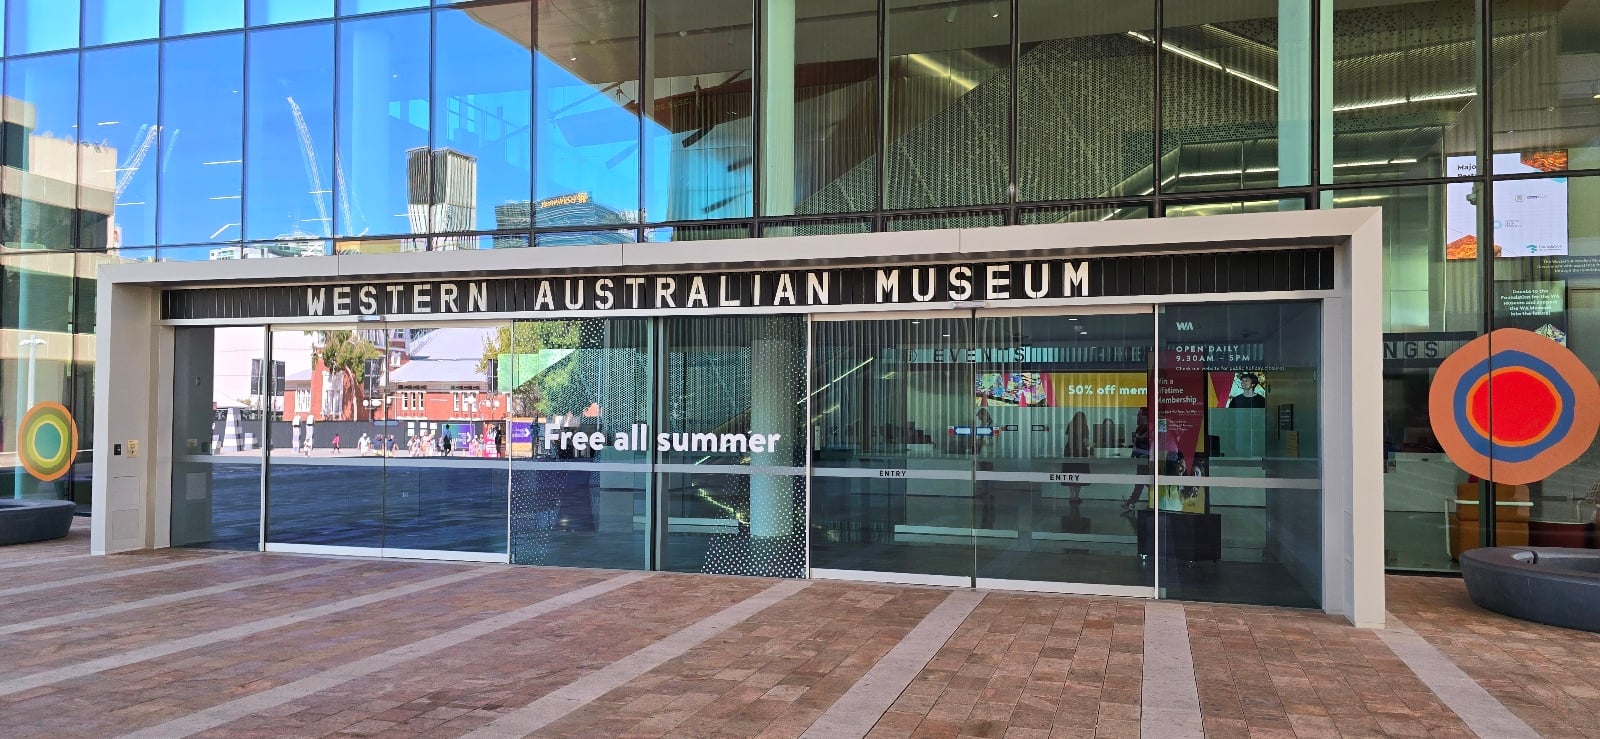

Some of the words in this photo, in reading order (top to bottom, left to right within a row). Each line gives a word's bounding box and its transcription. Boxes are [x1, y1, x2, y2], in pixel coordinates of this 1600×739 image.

[306, 281, 488, 316] WESTERN
[534, 271, 830, 311] AUSTRALIAN
[876, 261, 1090, 303] MUSEUM
[1176, 321, 1194, 331] WA
[1175, 345, 1205, 353] OPEN
[1208, 345, 1239, 353] DAILY
[934, 347, 1025, 363] EVENTS
[1229, 354, 1251, 362] 5PM
[1067, 385, 1094, 396] 50%
[1097, 385, 1116, 395] off
[1119, 386, 1148, 395] mem
[544, 423, 606, 451] Free
[614, 423, 648, 452] all
[657, 431, 782, 453] summer
[879, 470, 907, 478] ENTRY
[1049, 474, 1081, 482] ENTRY
